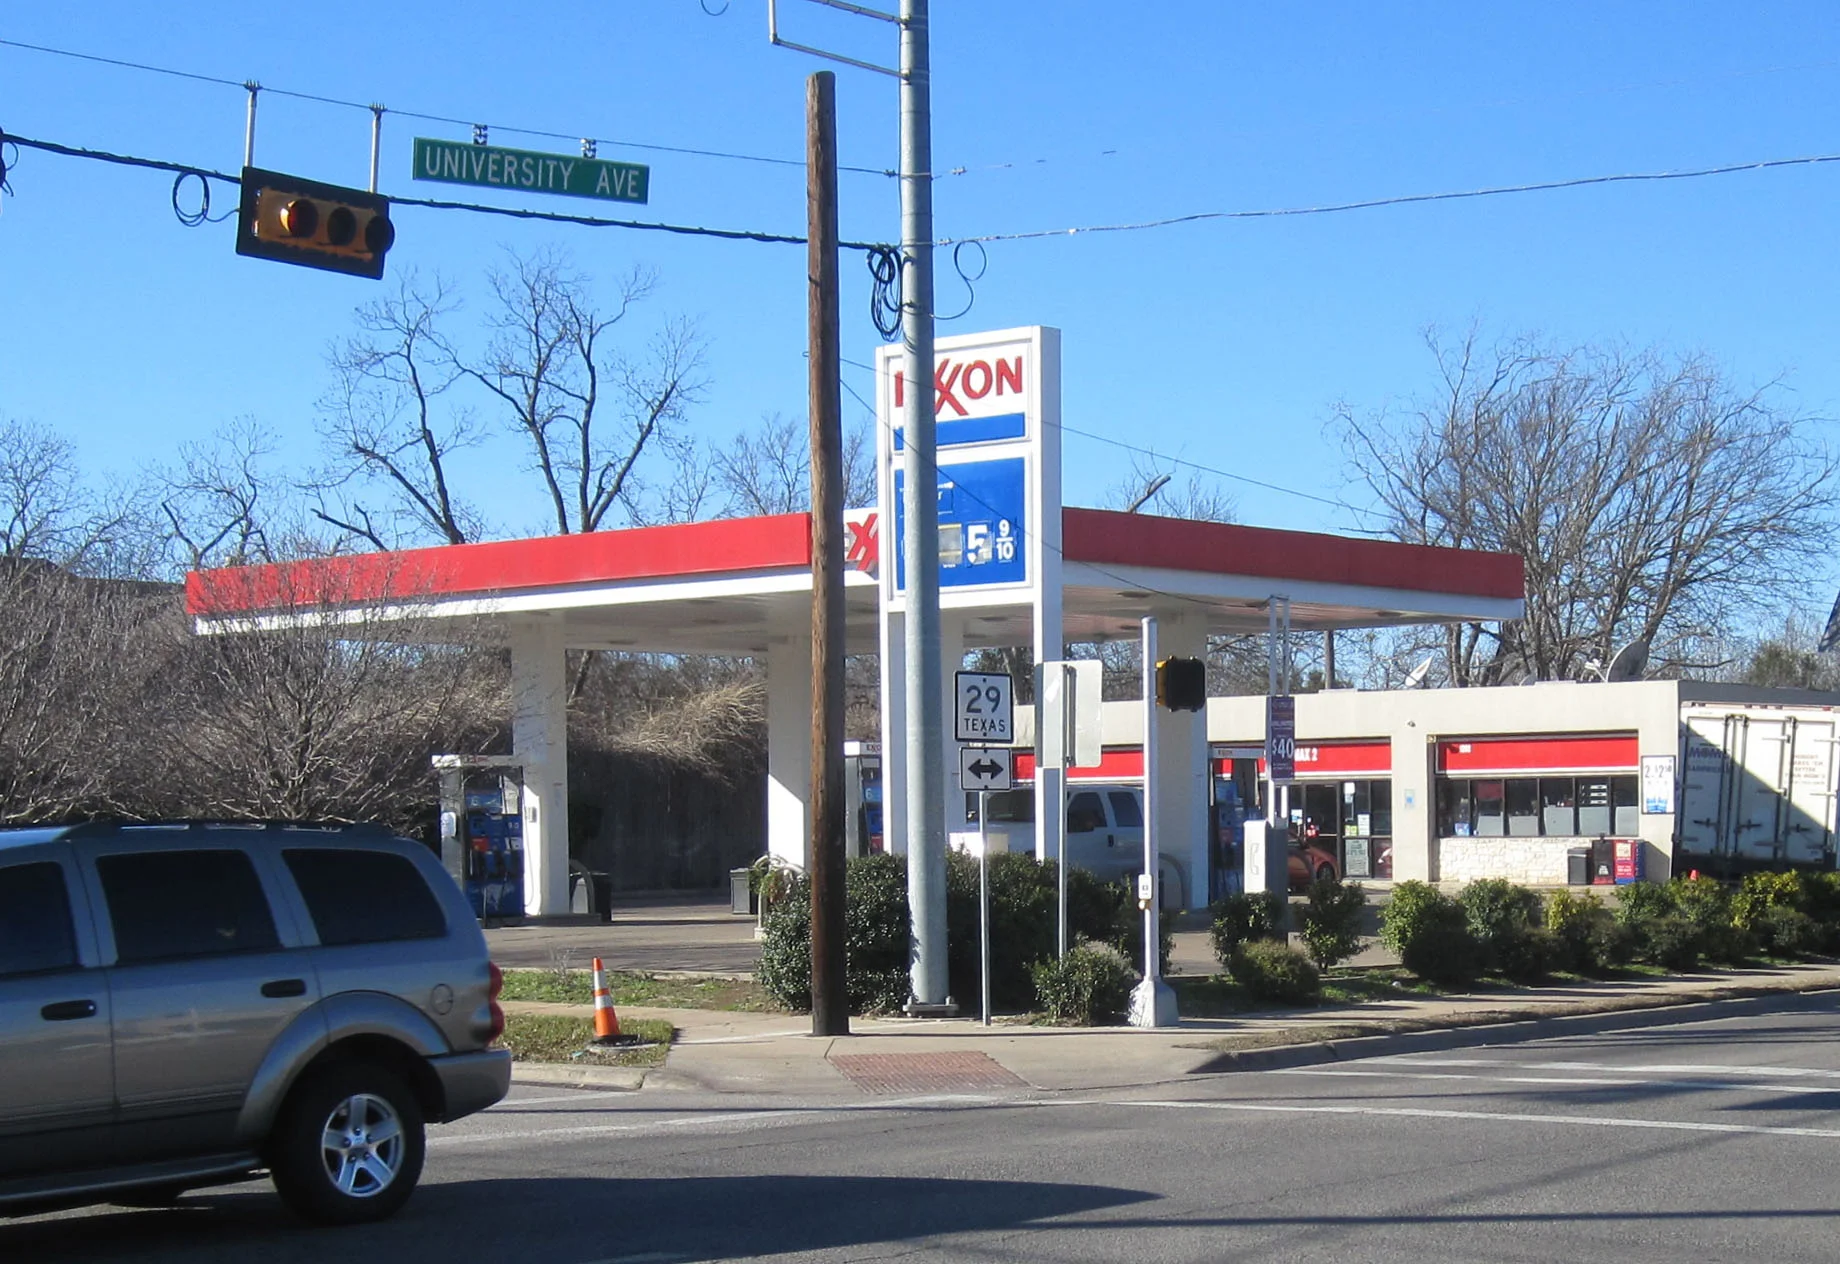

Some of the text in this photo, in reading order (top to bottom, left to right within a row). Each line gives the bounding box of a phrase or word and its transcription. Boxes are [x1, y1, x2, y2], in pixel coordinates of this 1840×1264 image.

[425, 146, 639, 198] UNIVERSITY AVE
[966, 685, 1001, 714] 29
[964, 718, 1006, 733] TEXAS
[1272, 738, 1294, 759] $40
